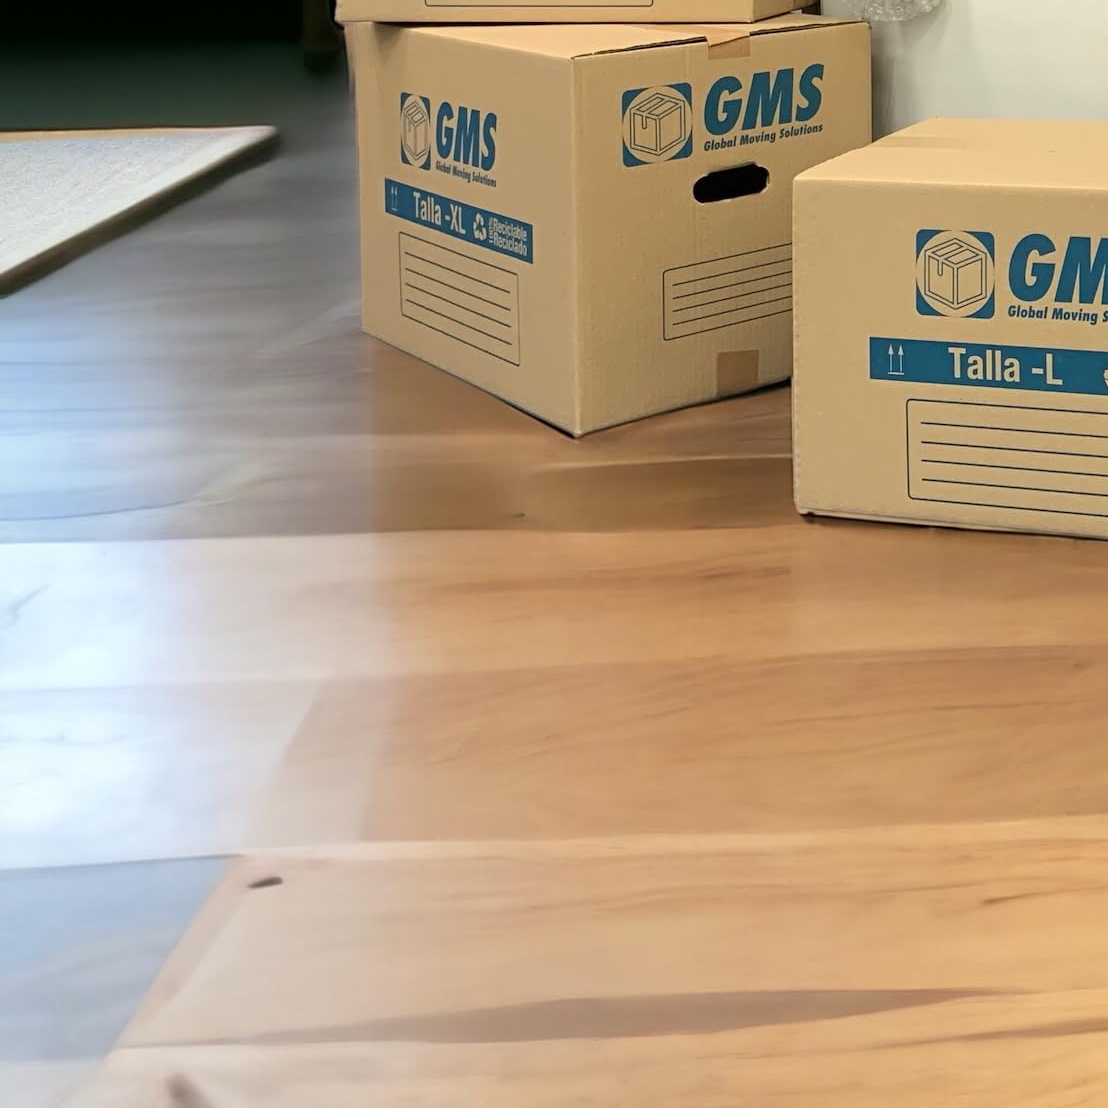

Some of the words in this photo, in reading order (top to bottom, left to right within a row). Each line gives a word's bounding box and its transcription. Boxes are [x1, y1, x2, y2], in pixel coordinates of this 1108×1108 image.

[704, 63, 825, 136] GMS
[436, 101, 497, 172] GMS
[703, 136, 737, 151] Global
[740, 132, 776, 145] Moving
[779, 123, 824, 139] Solutions
[436, 160, 451, 174] Global
[452, 165, 471, 183] Moving
[472, 171, 497, 188] Solutions
[413, 191, 441, 226] Talla
[445, 203, 466, 235] -XL
[493, 217, 528, 242] Reciclable
[493, 232, 528, 256] Reciclado
[1008, 305, 1048, 320] Global
[1051, 308, 1098, 326] Moving
[948, 346, 1021, 383] Talla
[1031, 353, 1064, 386] -L
